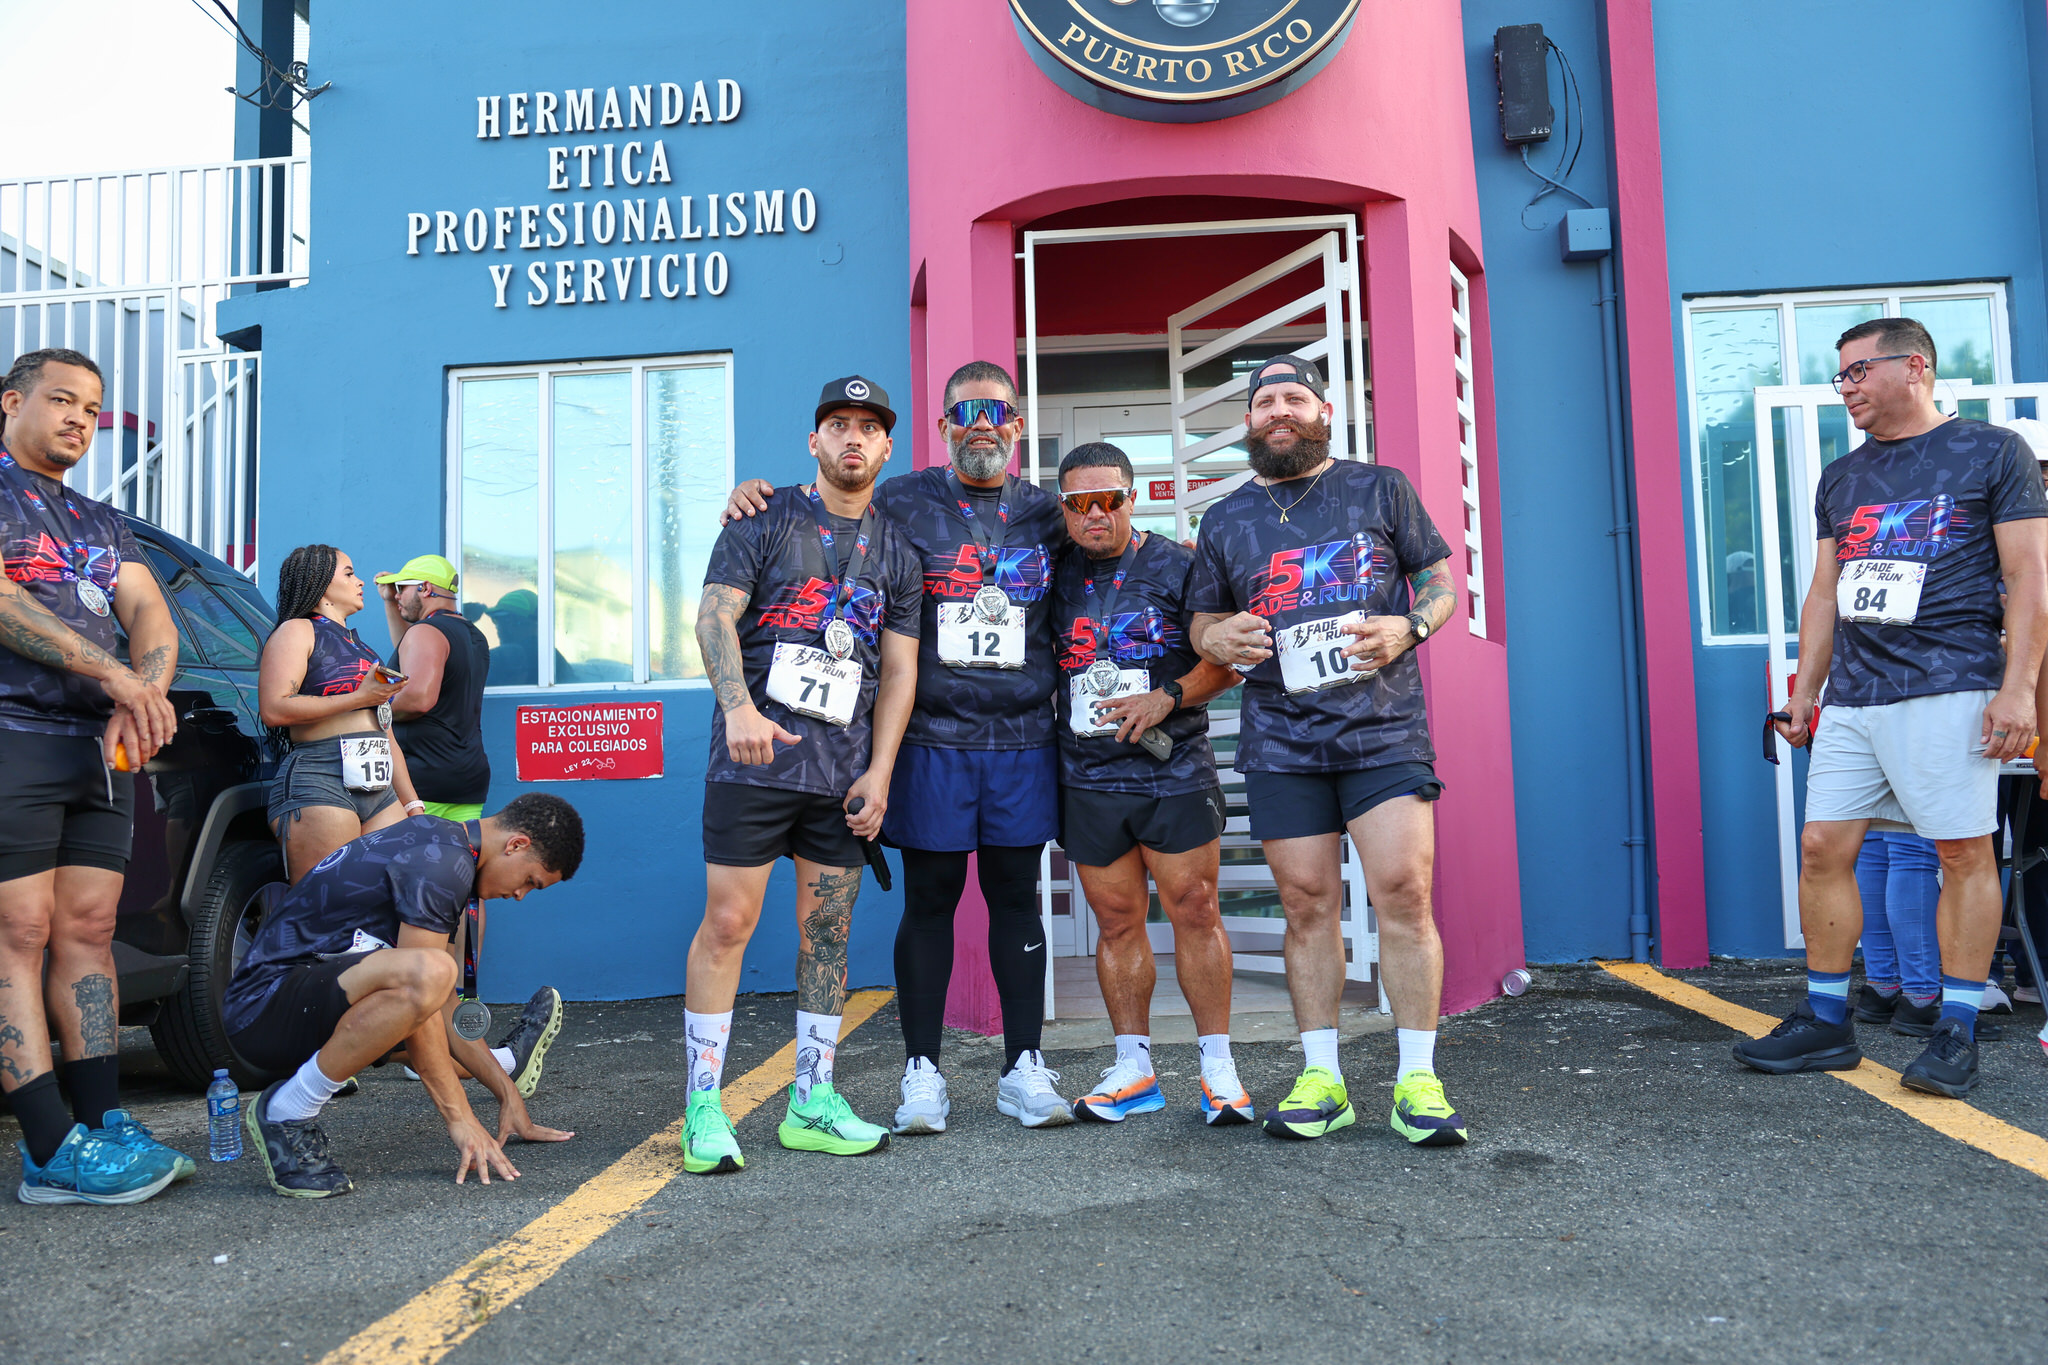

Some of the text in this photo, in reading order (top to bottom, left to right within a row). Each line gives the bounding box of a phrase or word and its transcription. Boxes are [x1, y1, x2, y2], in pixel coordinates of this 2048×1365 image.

[1057, 18, 1314, 83] PUERTO RICO
[476, 78, 742, 138] HERMANDAD
[547, 139, 672, 190] ETICA
[406, 187, 816, 255] PROFESIONALISMO
[488, 250, 729, 307] Y SERVICIO
[1154, 483, 1166, 491] NO
[1845, 499, 1931, 544] 5K
[1870, 543, 1885, 556] &
[1885, 540, 1940, 557] RUN
[1263, 539, 1351, 597] 5K
[1864, 562, 1895, 573] FADE
[1877, 573, 1903, 582] RUN
[1300, 590, 1316, 606] &
[1319, 584, 1368, 605] RUN
[1853, 586, 1888, 613] 84
[757, 613, 819, 630] FADE
[1307, 619, 1338, 635] FADE
[967, 631, 1001, 657] 12
[1115, 643, 1164, 662] RUN
[808, 650, 839, 668] FADE
[822, 665, 847, 680] RUN
[799, 675, 831, 708] 71
[521, 707, 657, 724] ESTACIONAMIENTO
[548, 723, 630, 738] EXCLUSIVO
[531, 738, 648, 754] PARA COLEGIADOS
[563, 762, 579, 774] LEY
